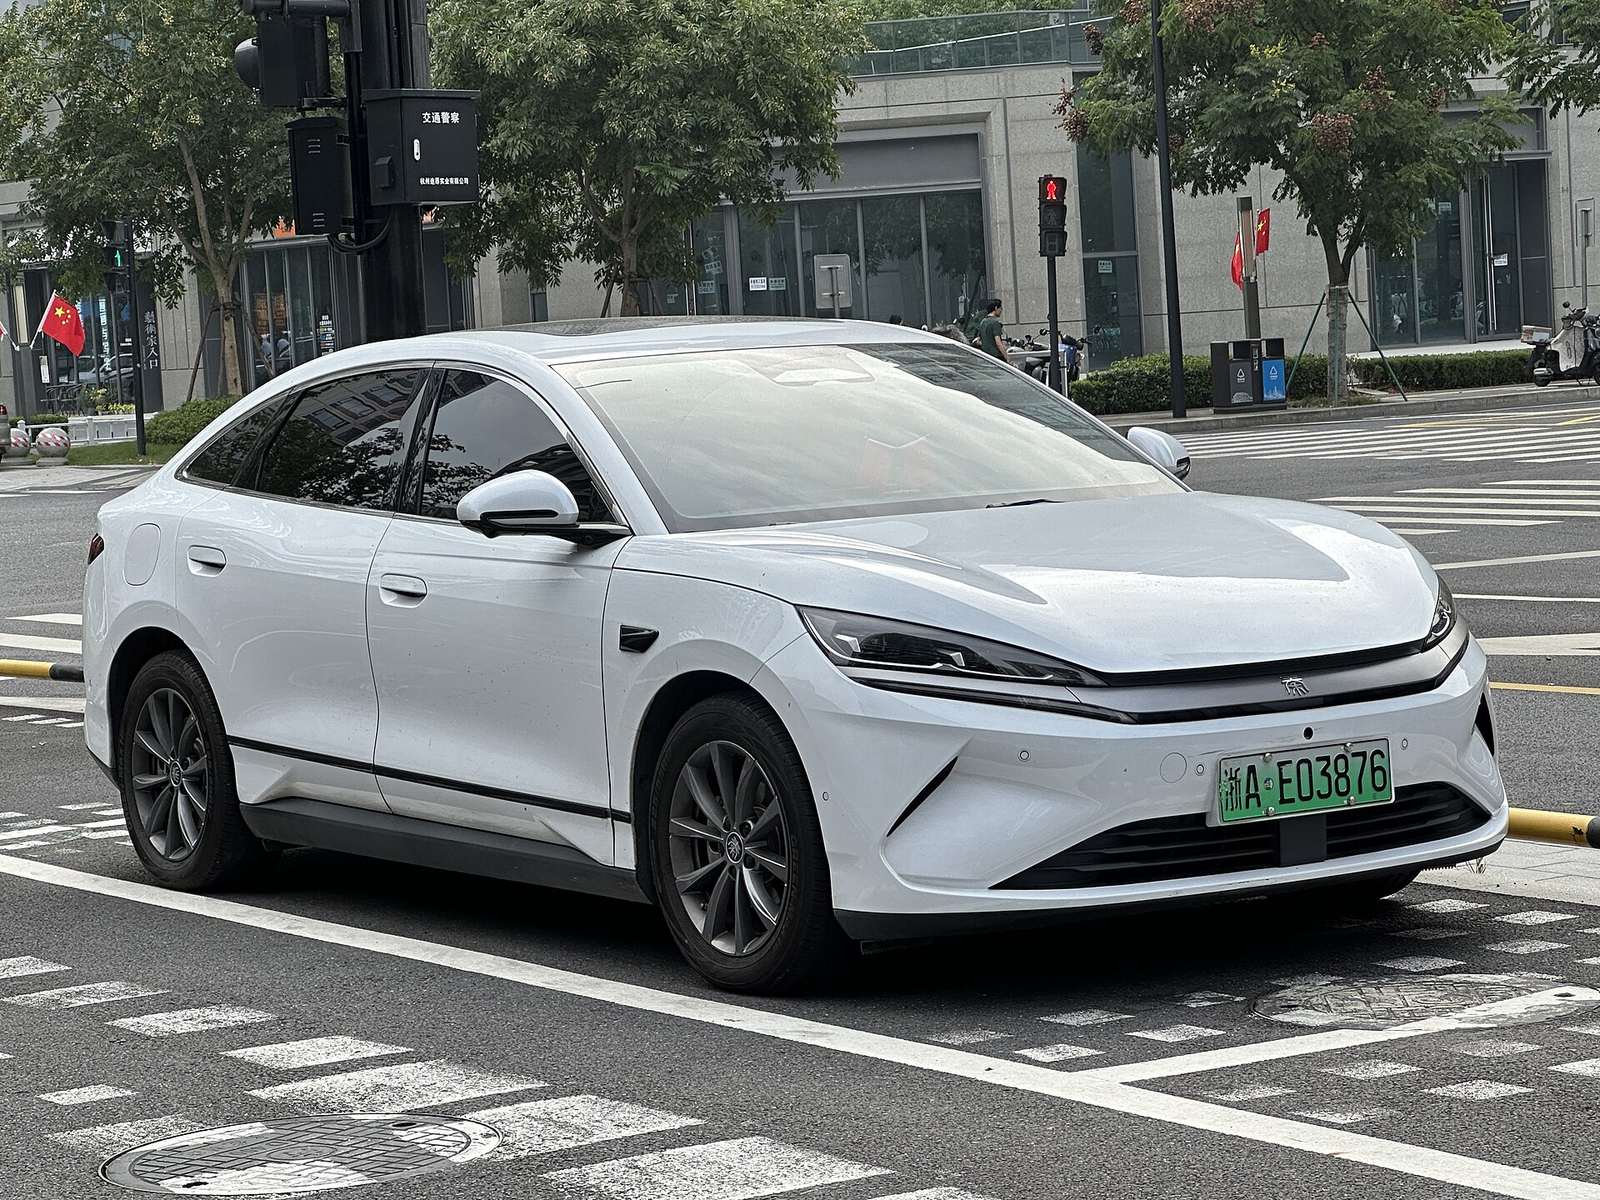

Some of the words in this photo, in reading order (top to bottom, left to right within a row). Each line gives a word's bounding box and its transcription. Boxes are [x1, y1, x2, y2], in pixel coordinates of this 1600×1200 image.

[421, 111, 460, 124] 交通警察
[1277, 750, 1387, 804] E03876
